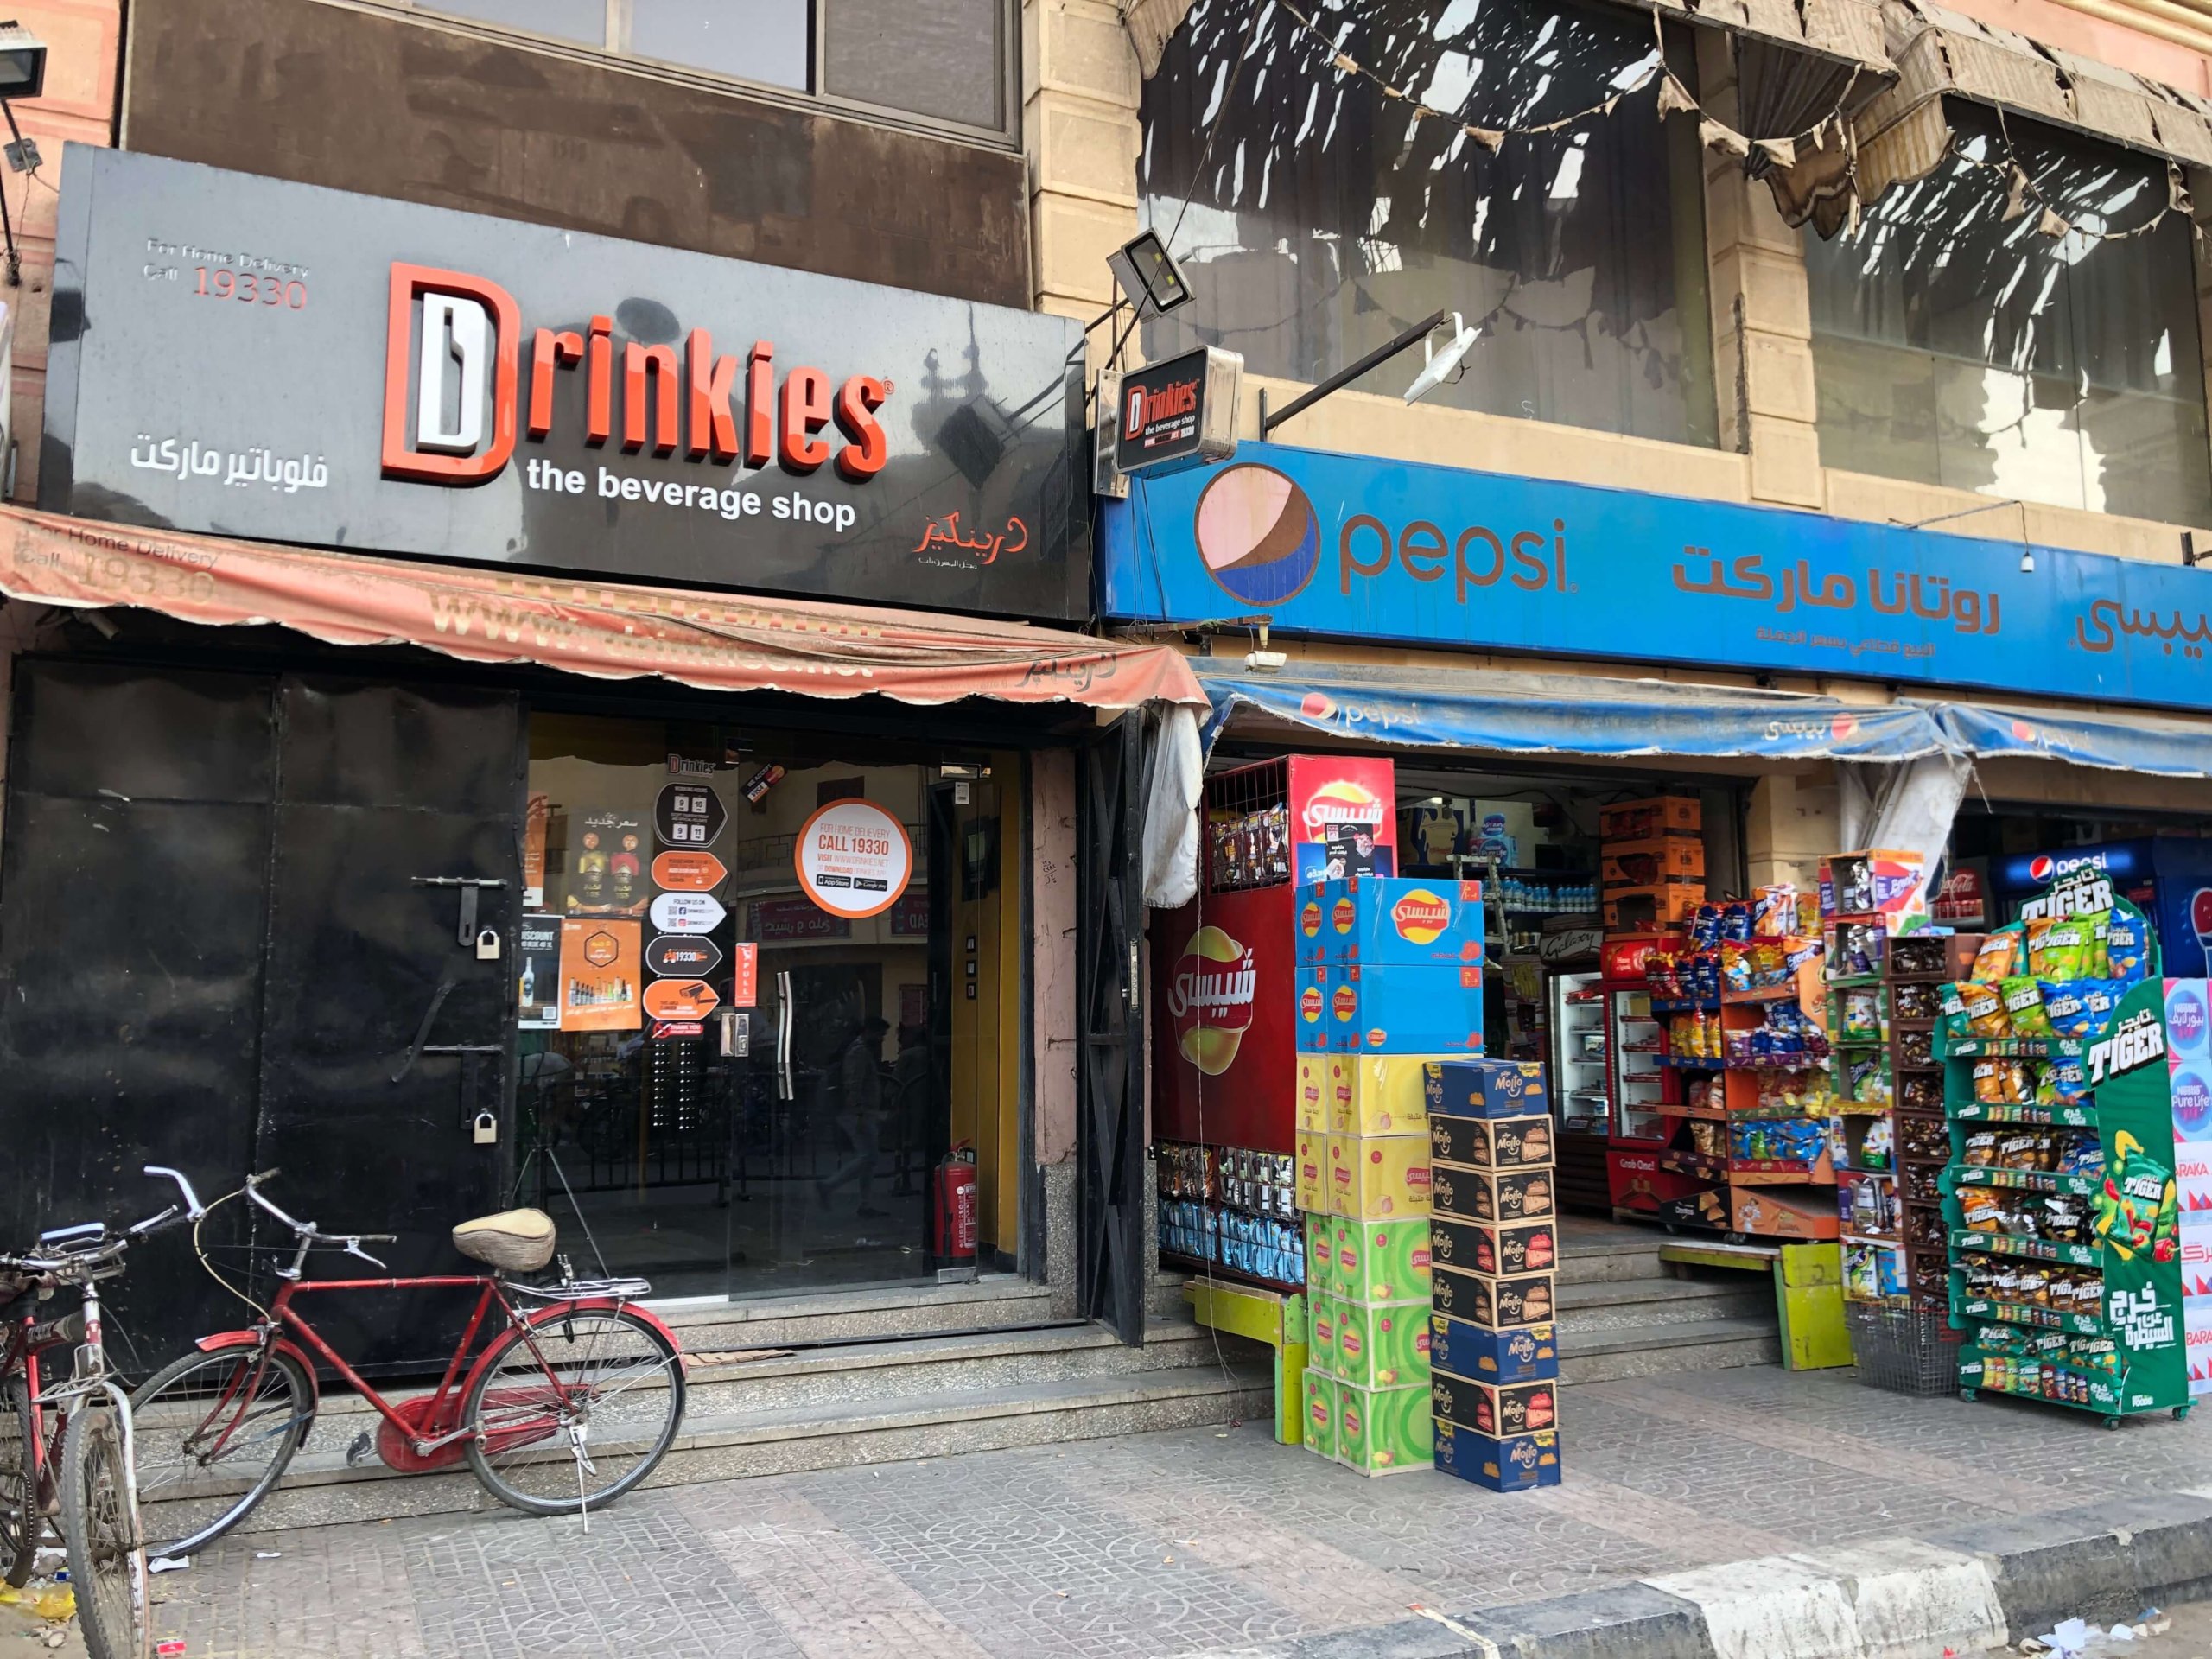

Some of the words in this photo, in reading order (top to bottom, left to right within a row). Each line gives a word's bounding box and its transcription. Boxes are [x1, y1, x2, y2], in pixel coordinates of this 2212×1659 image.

[147, 238, 177, 257] For
[182, 244, 234, 265] Home
[239, 252, 310, 279] Delivery
[143, 263, 179, 282] Call
[193, 266, 308, 310] 19330
[381, 262, 887, 487] Drinkies
[1125, 380, 1198, 441] Drinkies
[1155, 418, 1181, 434] beverage
[1181, 414, 1196, 427] shop
[131, 433, 221, 480] ماركت
[224, 446, 328, 493] فلوباتير
[526, 458, 587, 495] the
[597, 471, 762, 521] beverage
[771, 490, 856, 532] shop
[912, 509, 1029, 565] درينكيز
[68, 527, 130, 551] Home
[136, 539, 219, 569] Delivery
[1339, 514, 1566, 605] pepsi
[1672, 545, 1856, 613] ماركت
[1868, 568, 2001, 635] روتانا
[1344, 701, 1422, 729] pepsi
[820, 823, 834, 834] FOR
[835, 824, 855, 836] HOME
[818, 834, 849, 852] CALL
[851, 837, 889, 855] 19330
[817, 853, 833, 862] VISIT
[2021, 880, 2114, 921] TIGER
[1547, 931, 1594, 957] Galaxy
[2088, 1022, 2164, 1085] TIGER
[1495, 1074, 1522, 1094] Molto
[2171, 1095, 2194, 1108] Pure
[2194, 1094, 2209, 1111] Life
[1432, 1130, 1452, 1150] Molto
[1497, 1135, 1521, 1154] Molto
[1619, 1158, 1637, 1169] Grab
[1637, 1160, 1656, 1171] One!
[1433, 1182, 1454, 1201] Molto
[1500, 1188, 1522, 1206] Molto
[2124, 1178, 2163, 1200] TIGER
[1432, 1235, 1453, 1255] Molto
[1503, 1243, 1525, 1260] Molto
[1499, 1294, 1522, 1312] Molto
[1508, 1338, 1535, 1358] Molto
[1432, 1389, 1452, 1410] Molto
[1502, 1402, 1526, 1420] Molto
[1510, 1444, 1537, 1465] Molto
